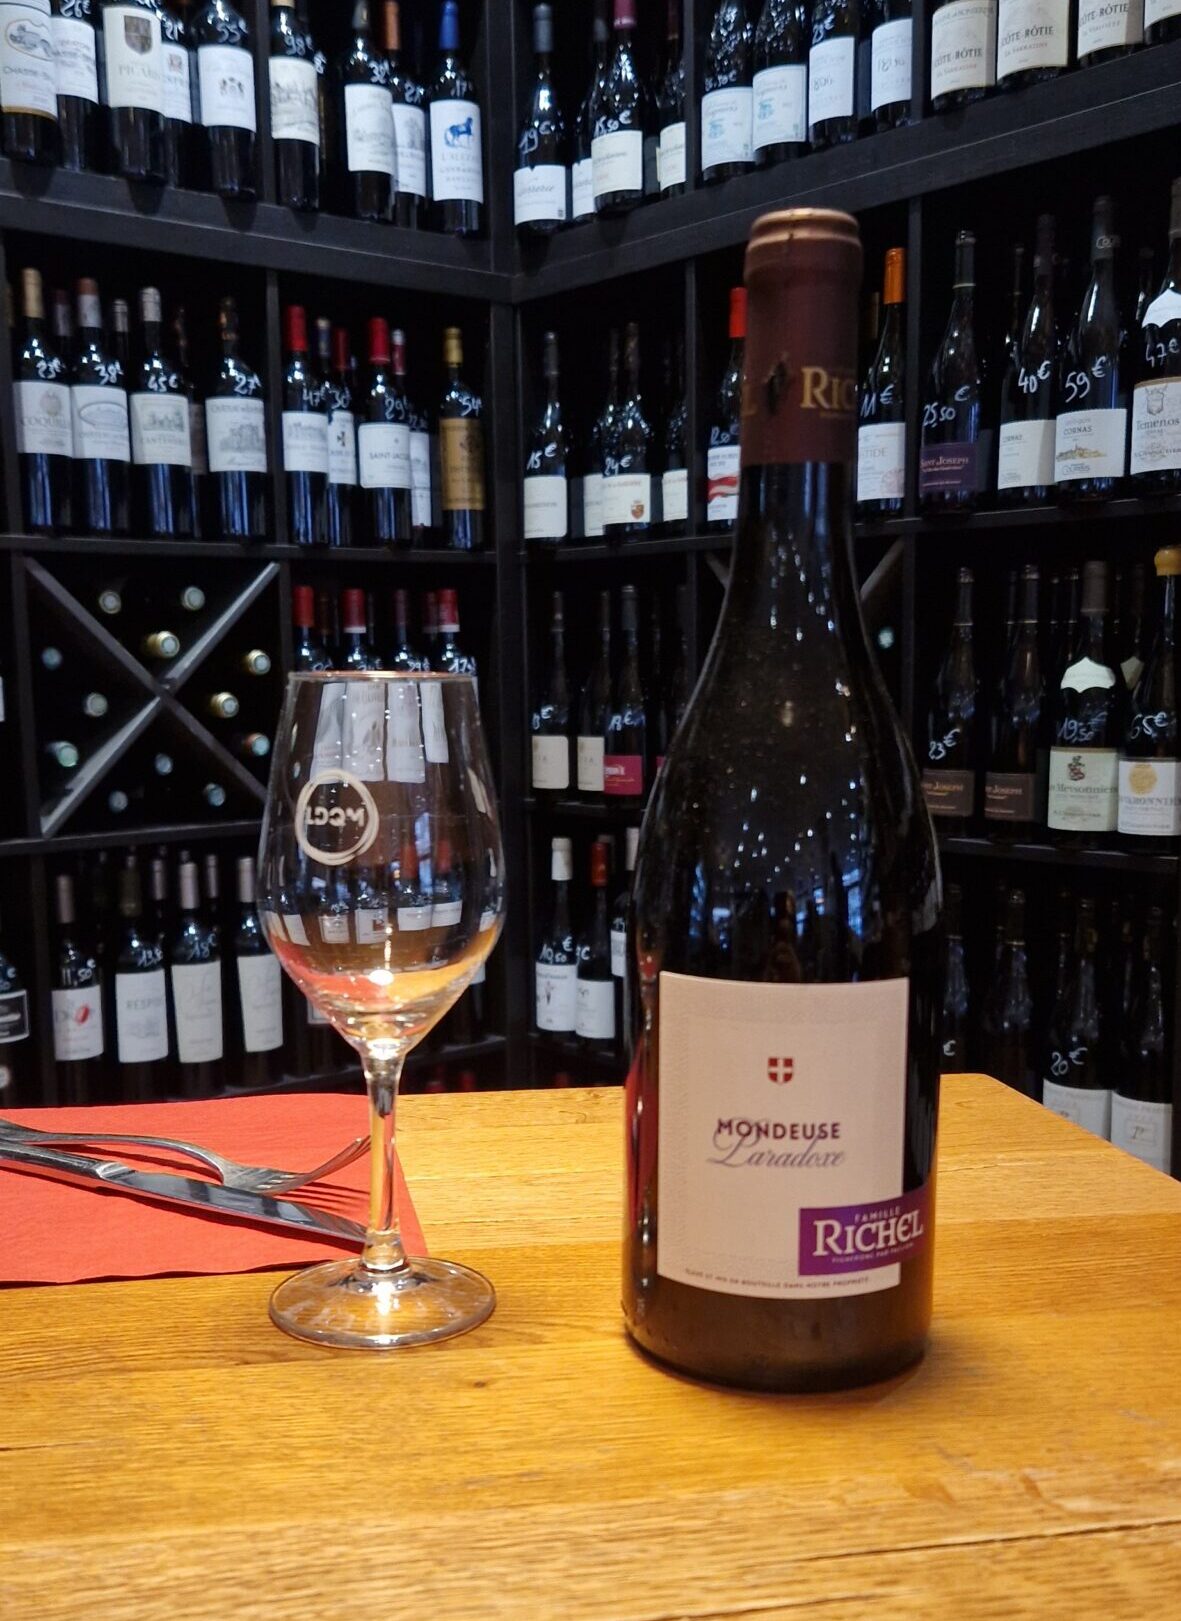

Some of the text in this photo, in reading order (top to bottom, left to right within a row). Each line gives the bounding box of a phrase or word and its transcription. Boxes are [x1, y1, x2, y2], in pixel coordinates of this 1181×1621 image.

[717, 1118, 841, 1140] MONDEUSE
[706, 1116, 847, 1169] Paradoxe
[854, 1205, 901, 1223] FAMILLE
